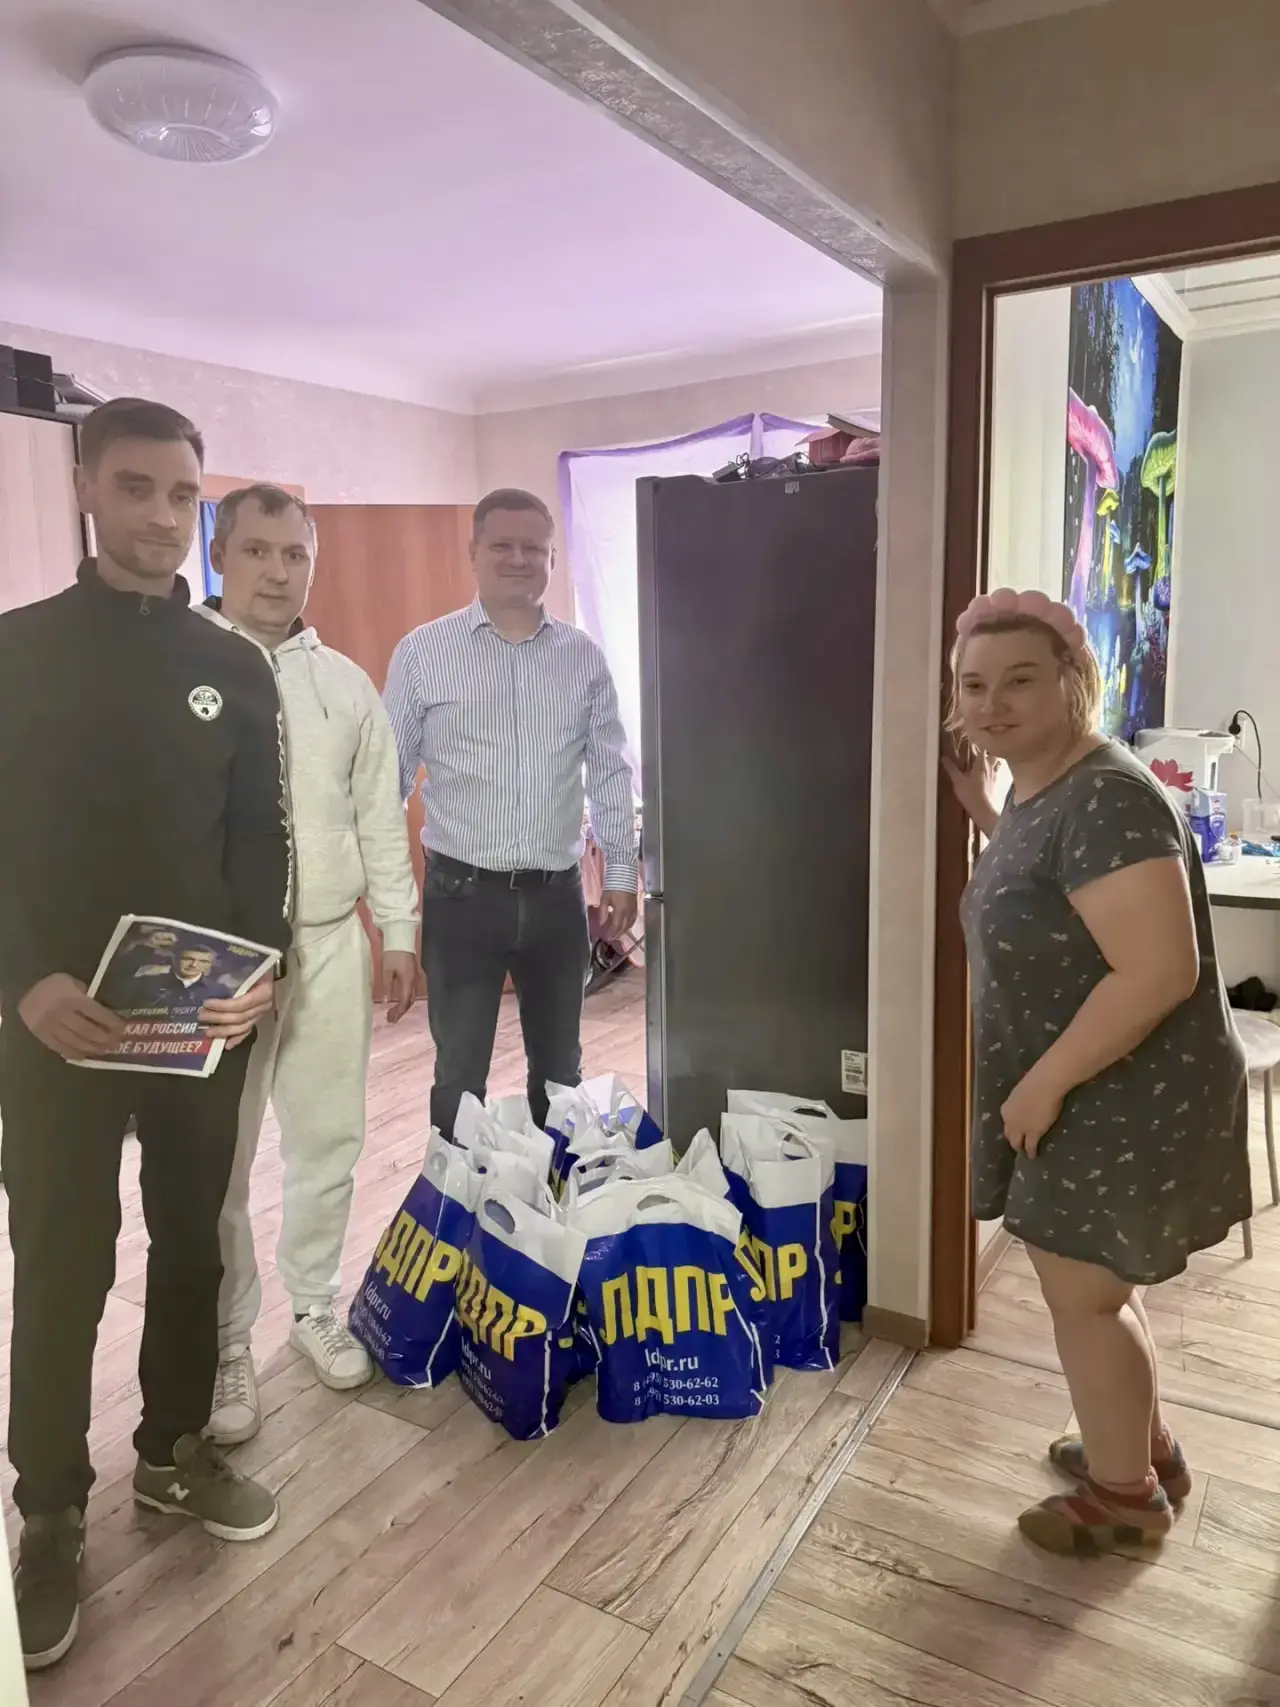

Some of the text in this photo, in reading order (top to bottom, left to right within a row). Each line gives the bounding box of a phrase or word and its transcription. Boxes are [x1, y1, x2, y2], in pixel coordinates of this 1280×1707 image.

[124, 1023, 150, 1036] КАЯ
[150, 1022, 198, 1034] РОССИЯ
[132, 1041, 203, 1054] БУДУЩЕЕ?
[365, 1281, 392, 1320] ldpr.ru
[600, 1265, 735, 1345] ЛДПР
[462, 1336, 490, 1380] ldpr.ru
[645, 1347, 699, 1372] ldpr.ru
[633, 1381, 641, 1392] 8
[663, 1376, 720, 1390] 530-62-62
[663, 1393, 720, 1406] 530-62-03
